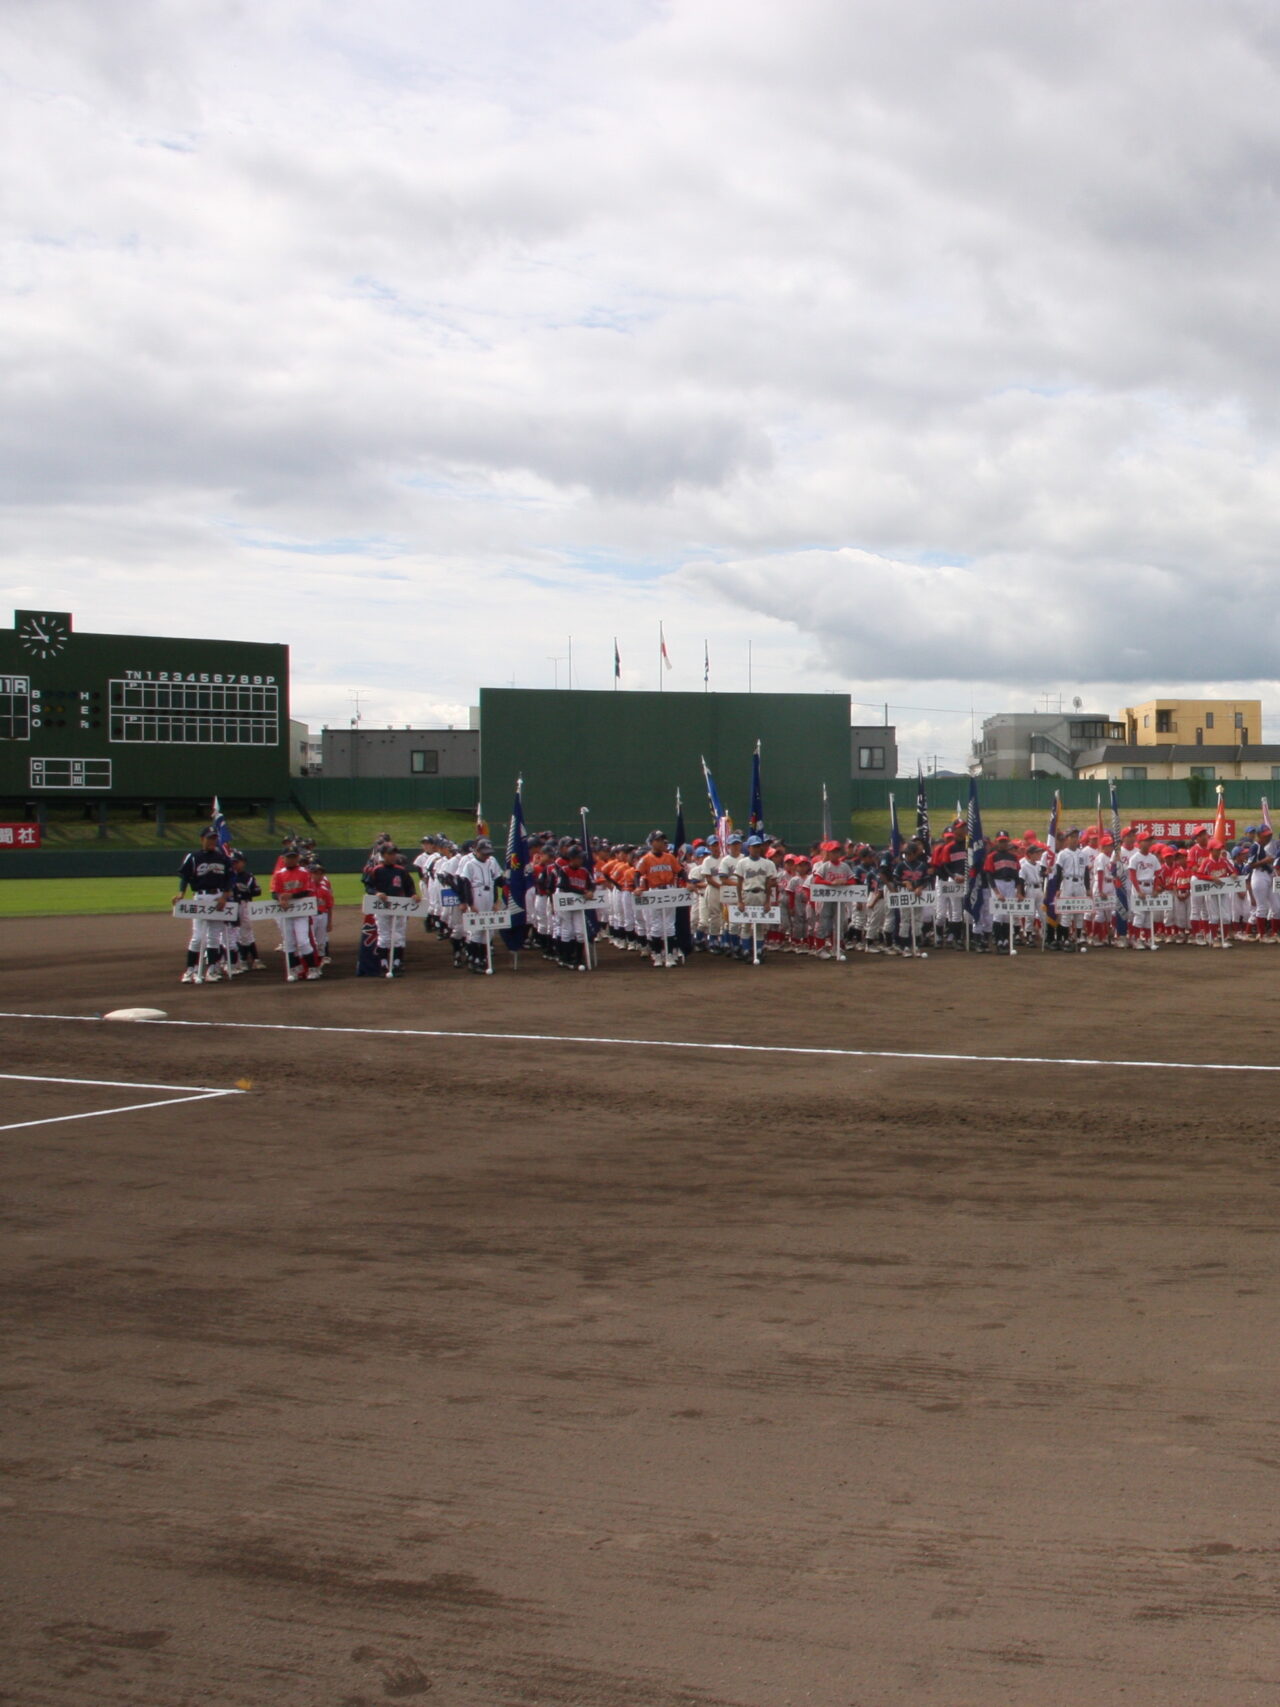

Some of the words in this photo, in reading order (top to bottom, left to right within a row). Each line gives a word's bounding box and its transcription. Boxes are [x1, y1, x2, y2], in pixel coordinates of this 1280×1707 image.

[146, 671, 152, 680] 1
[159, 671, 168, 681] 2
[172, 672, 182, 681] 3
[186, 673, 196, 682] 4
[200, 673, 209, 682] 5
[213, 674, 223, 683] 6
[227, 674, 236, 683] 7
[240, 675, 249, 684] 8
[253, 676, 262, 684] 9
[266, 676, 275, 685] P
[31, 690, 41, 698] B
[80, 692, 89, 700] H
[31, 704, 41, 713] S
[80, 706, 89, 714] E
[33, 762, 42, 771] C
[890, 893, 935, 906] 前田リトル
